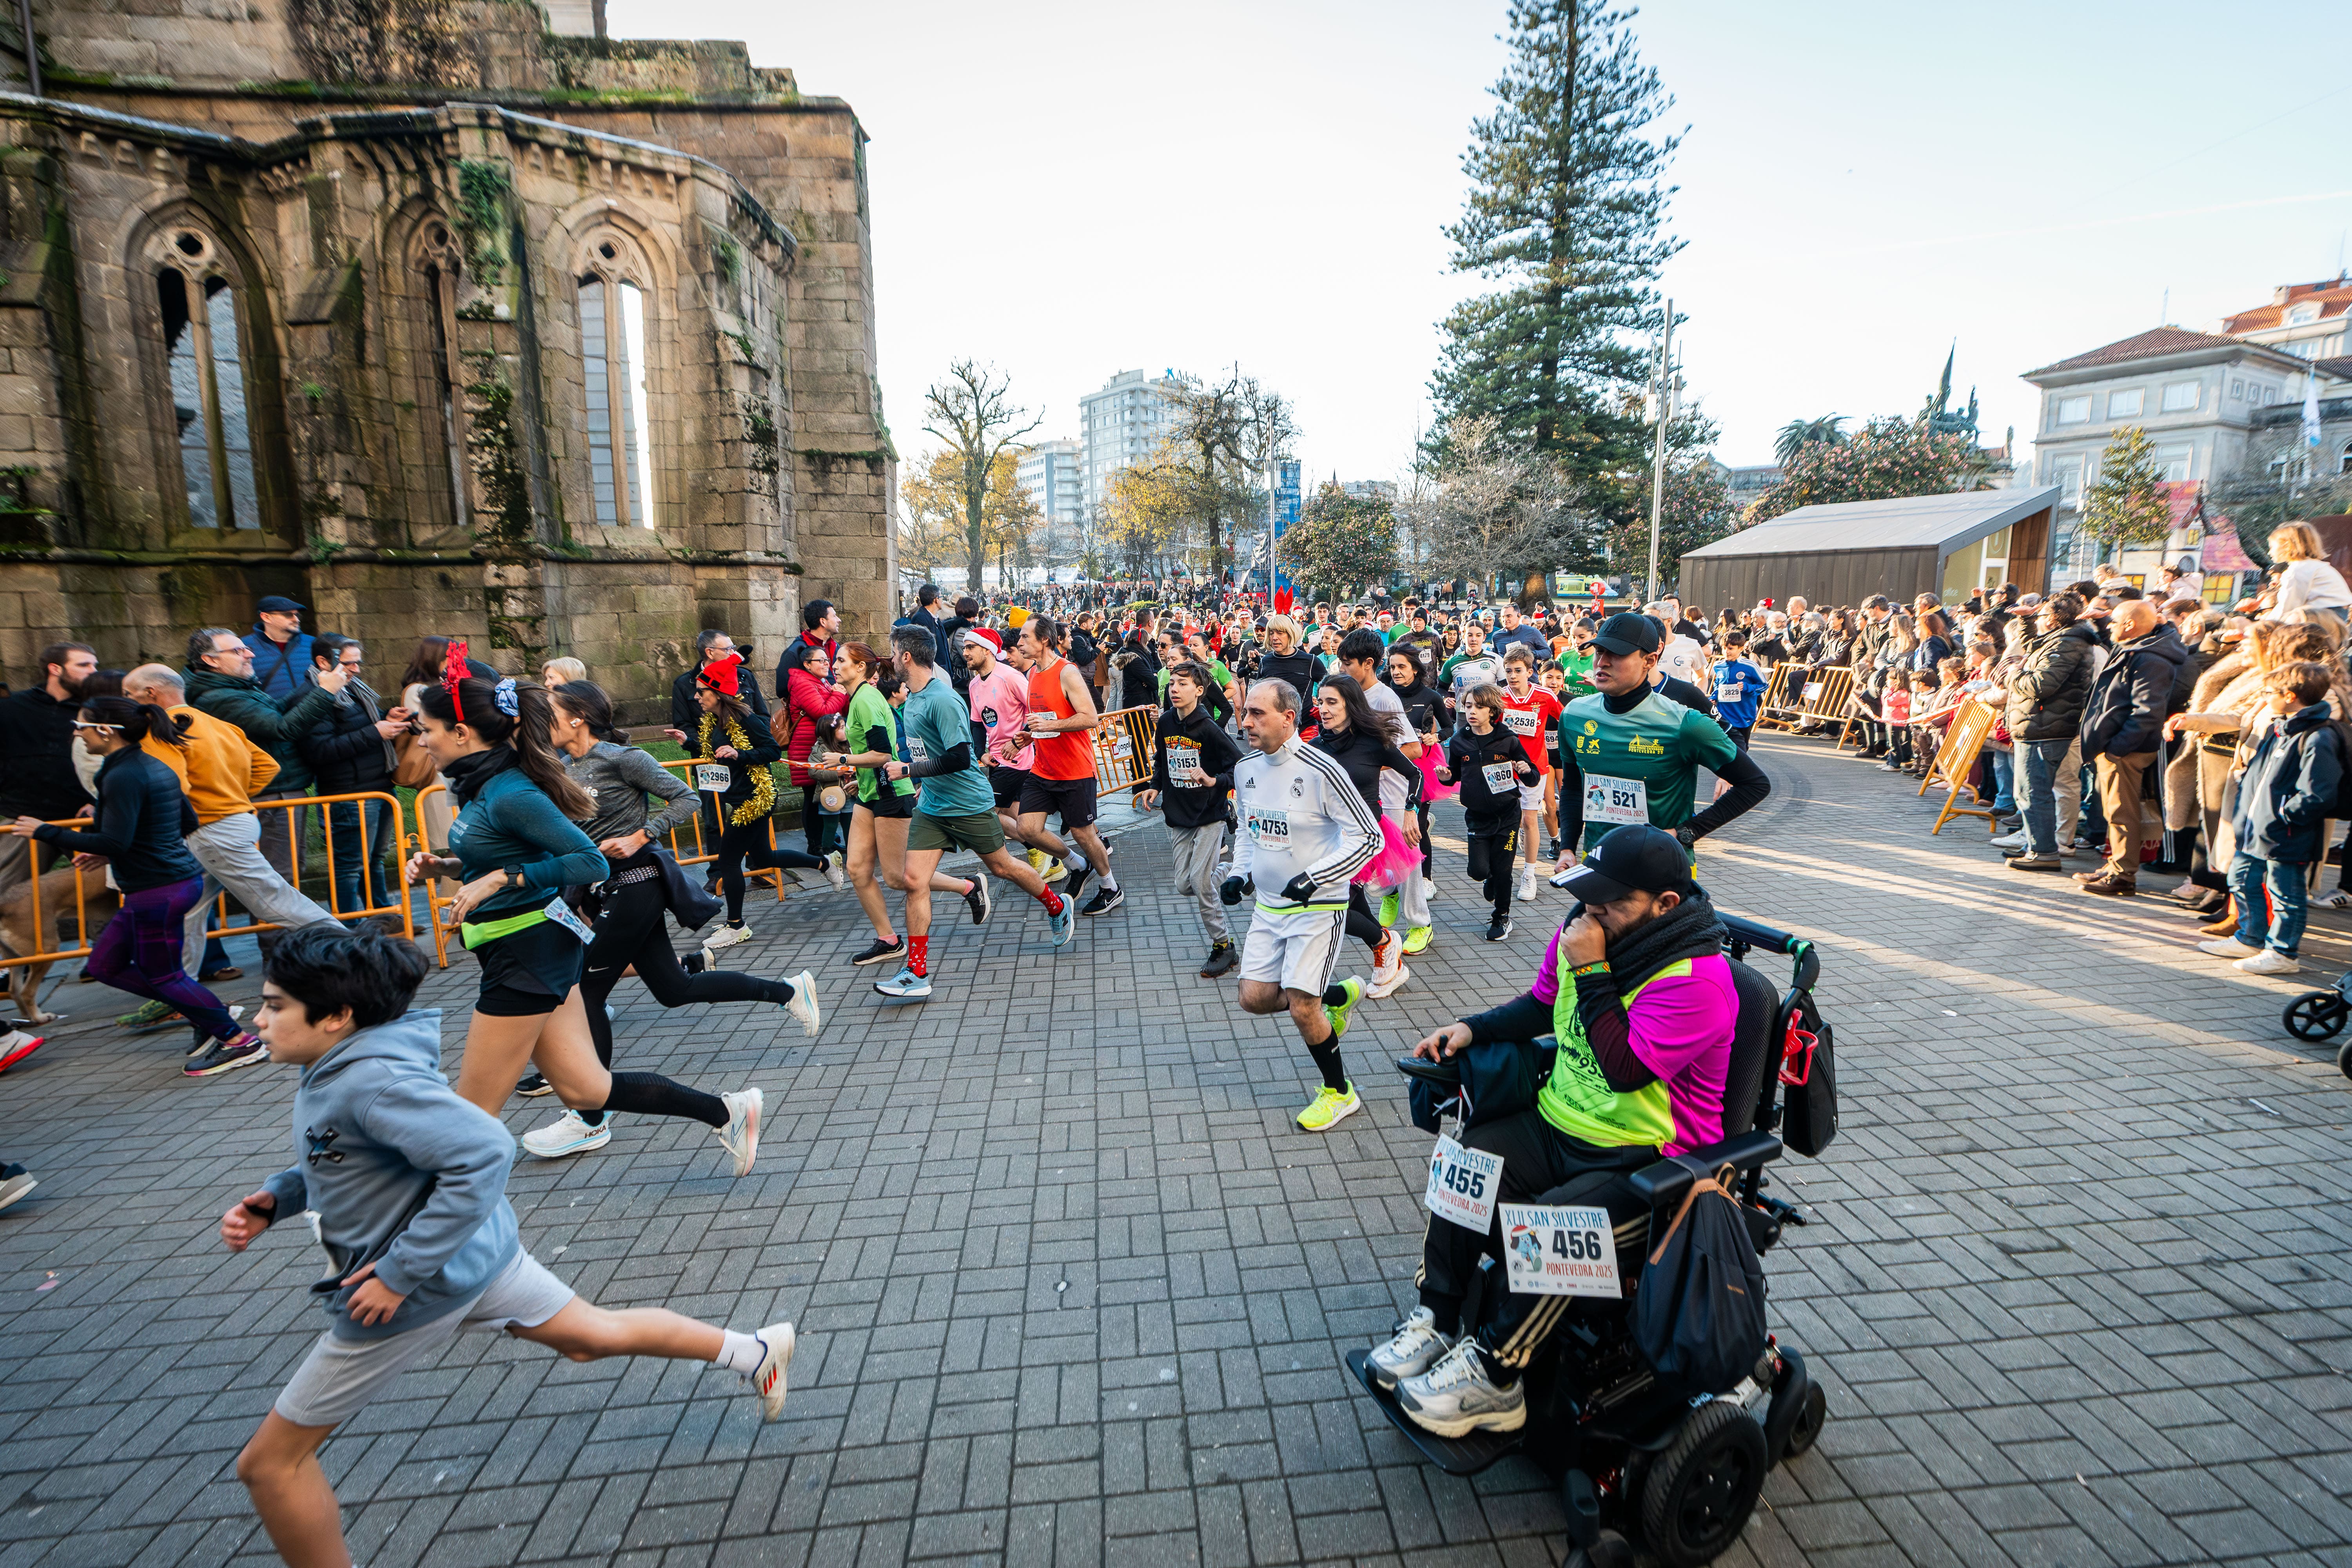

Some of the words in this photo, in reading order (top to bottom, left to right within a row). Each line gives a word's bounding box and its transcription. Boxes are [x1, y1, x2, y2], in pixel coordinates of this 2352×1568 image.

[1514, 717, 1535, 727] 2538
[1176, 757, 1197, 768] 5153
[710, 771, 729, 782] 2966
[1599, 778, 1612, 788] SAN
[1612, 780, 1642, 793] SILVESTRE
[1612, 790, 1637, 809] 521
[1256, 809, 1265, 818] SAN
[1266, 810, 1288, 821] SILVESTRE
[1606, 806, 1632, 816] PONTEVEDRA
[1261, 819, 1288, 836] 4753
[1261, 835, 1281, 843] PONTEVEDRA
[584, 1125, 606, 1139] HOKA
[1452, 1148, 1497, 1176] SILVESTRE
[1445, 1163, 1486, 1200] 455
[1437, 1188, 1470, 1211] PONTEVEDRA
[1471, 1201, 1488, 1217] 2025
[1528, 1210, 1549, 1228] SAN
[1551, 1210, 1605, 1229] SILVESTRE
[1552, 1229, 1602, 1261] 456
[1546, 1262, 1593, 1278] PONTEVEDRA
[1595, 1265, 1613, 1279] 2025
